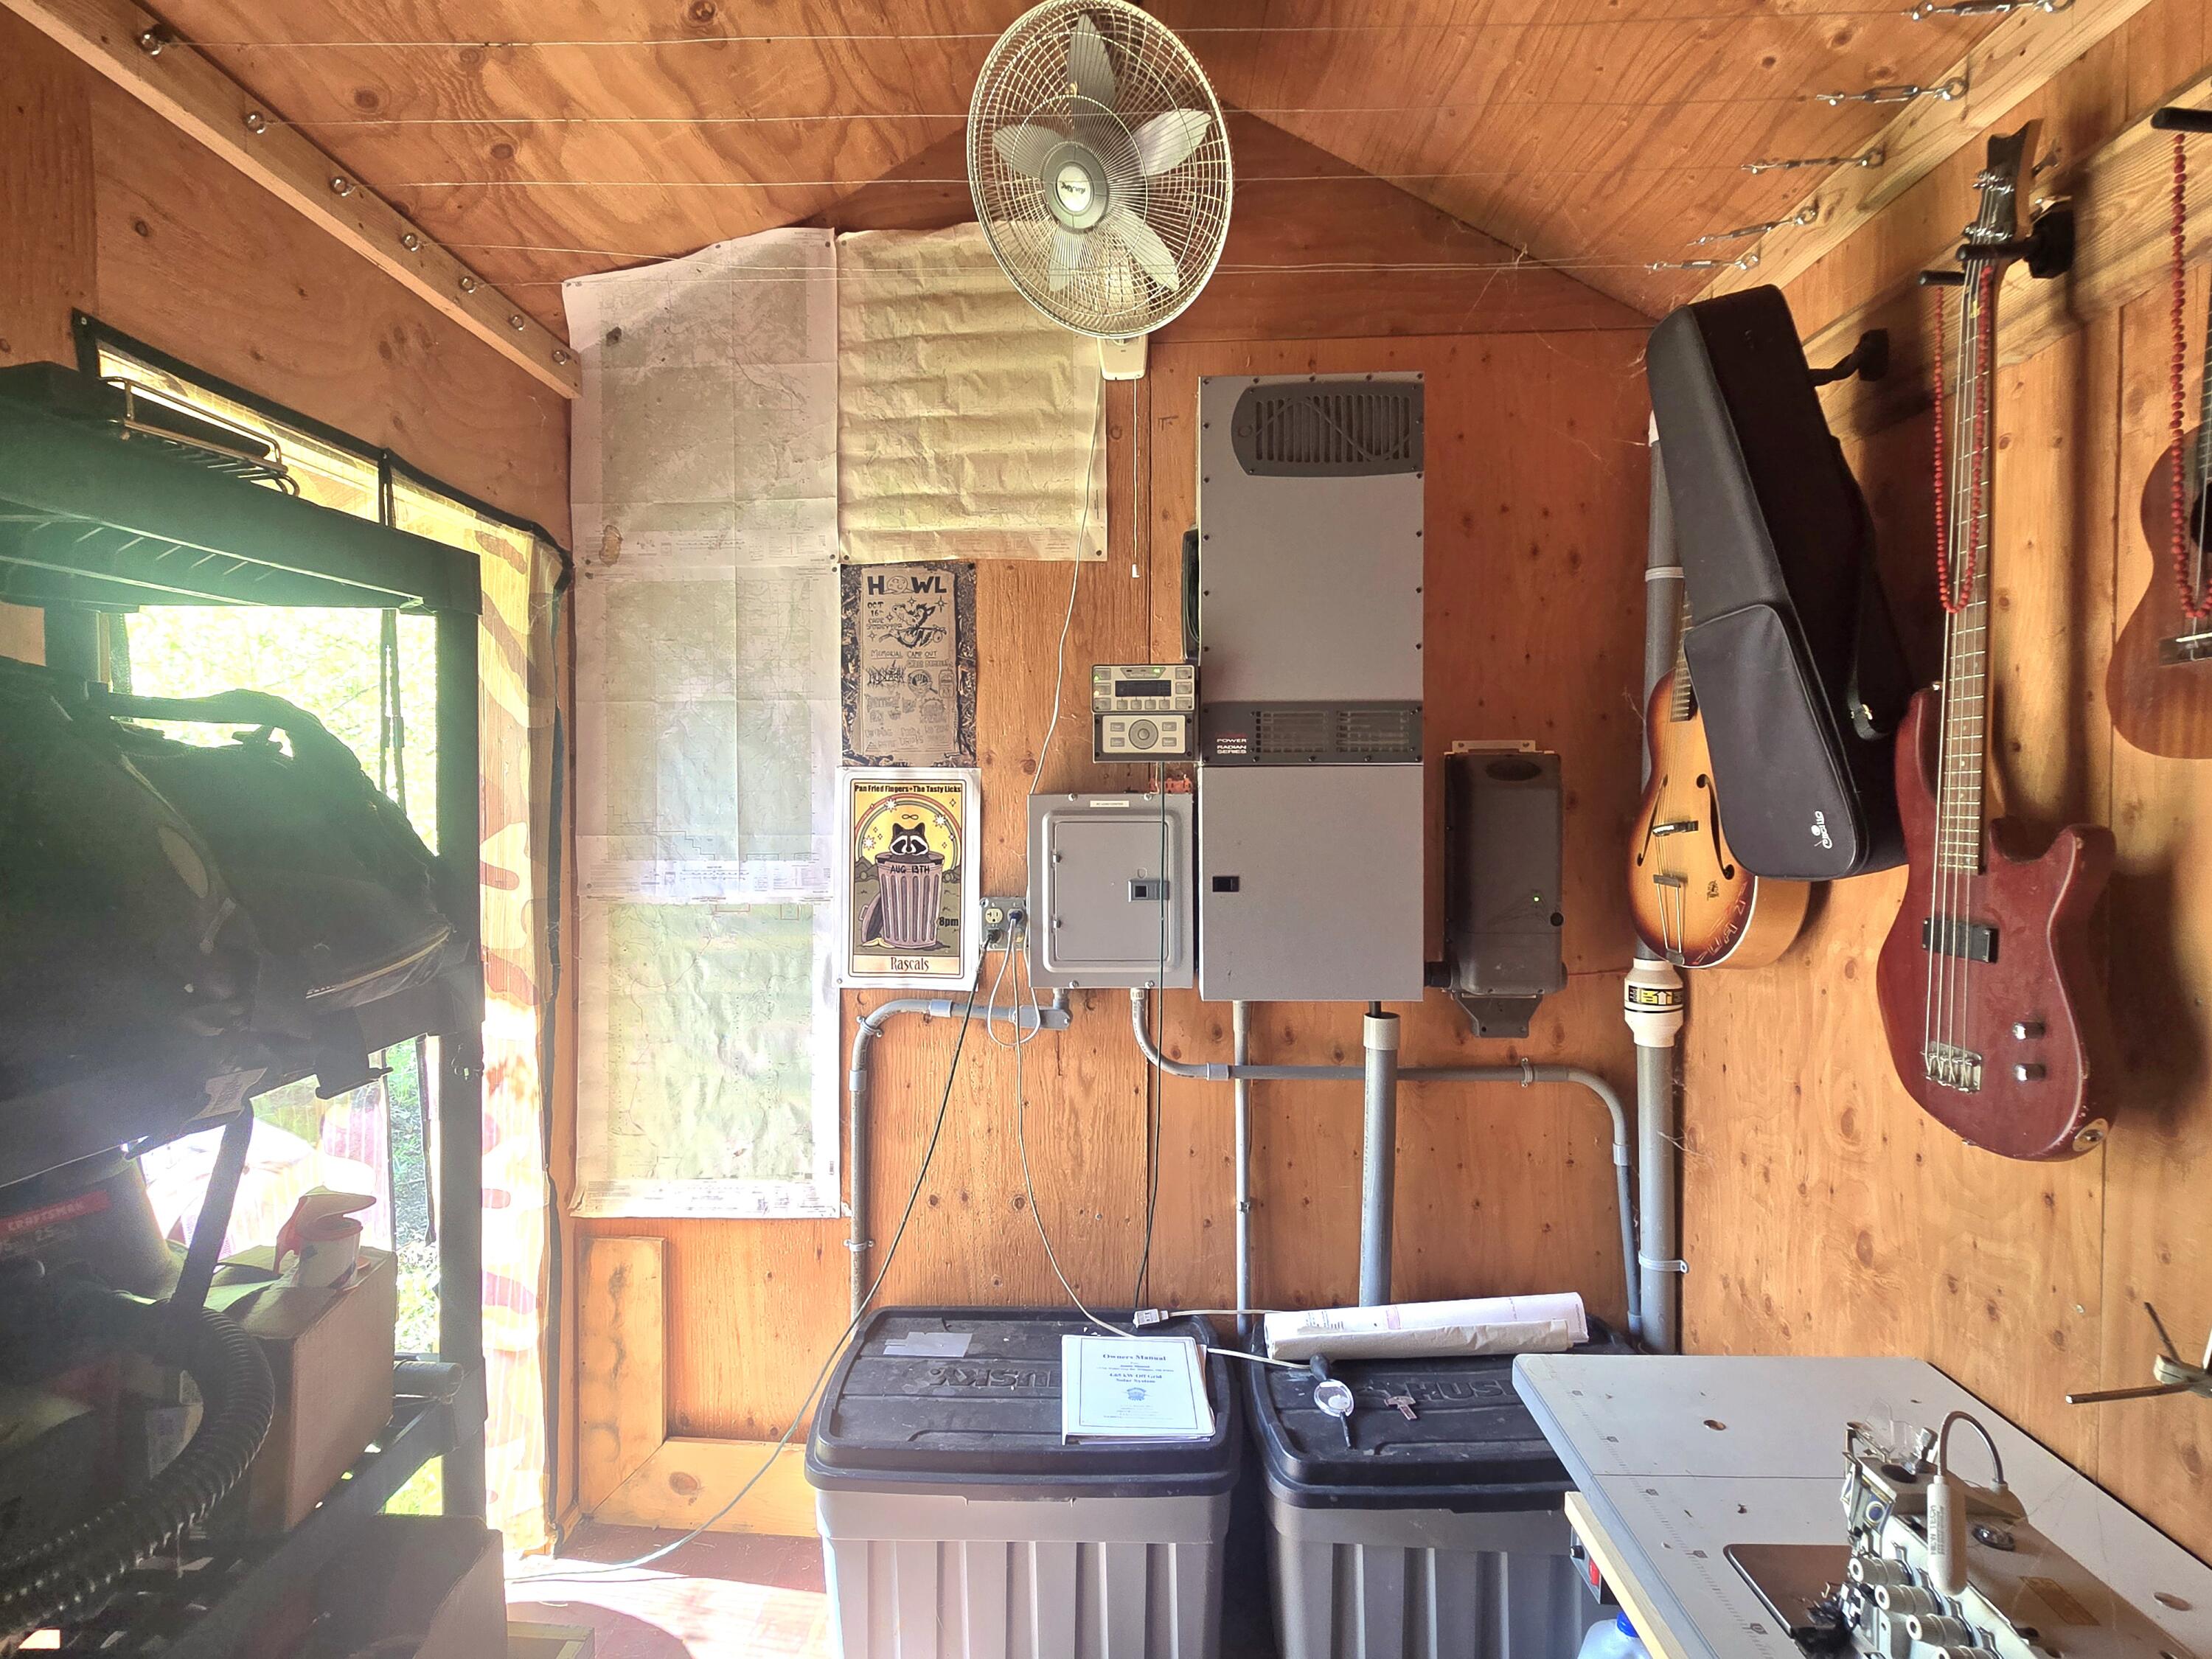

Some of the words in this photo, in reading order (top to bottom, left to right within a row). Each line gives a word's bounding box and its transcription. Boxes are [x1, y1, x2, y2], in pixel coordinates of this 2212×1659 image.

[867, 601, 884, 609] OCT
[870, 649, 902, 658] MEMORIAL
[890, 865, 906, 874] AUG
[911, 865, 931, 874] 13TH
[939, 917, 959, 927] 8pm
[891, 956, 929, 972] Rascals
